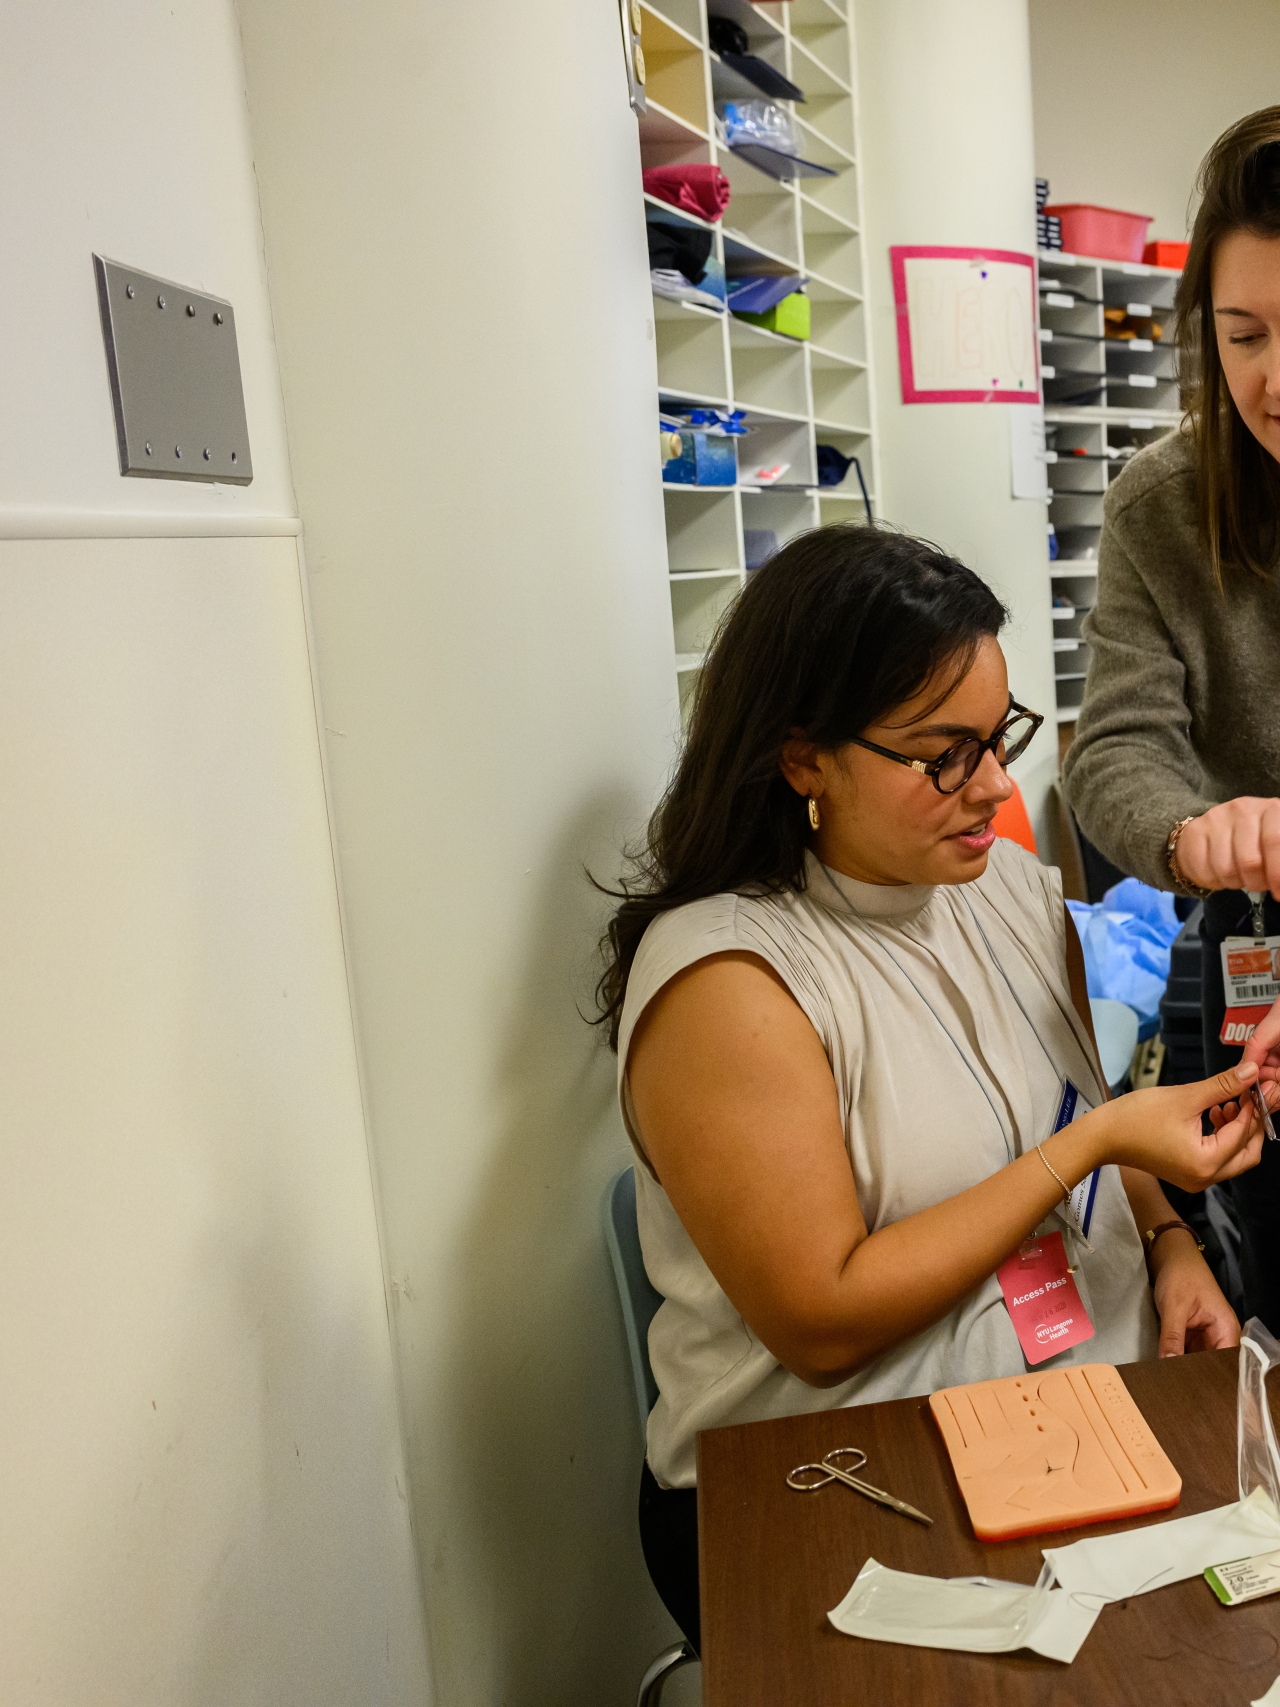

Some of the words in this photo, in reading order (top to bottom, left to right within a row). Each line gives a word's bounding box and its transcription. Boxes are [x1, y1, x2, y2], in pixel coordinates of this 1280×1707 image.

[1012, 1286, 1045, 1307] Access
[1045, 1277, 1067, 1292] Pass
[1036, 1327, 1050, 1339] NYU
[1049, 1317, 1074, 1333] Langone
[1049, 1326, 1070, 1341] Health
